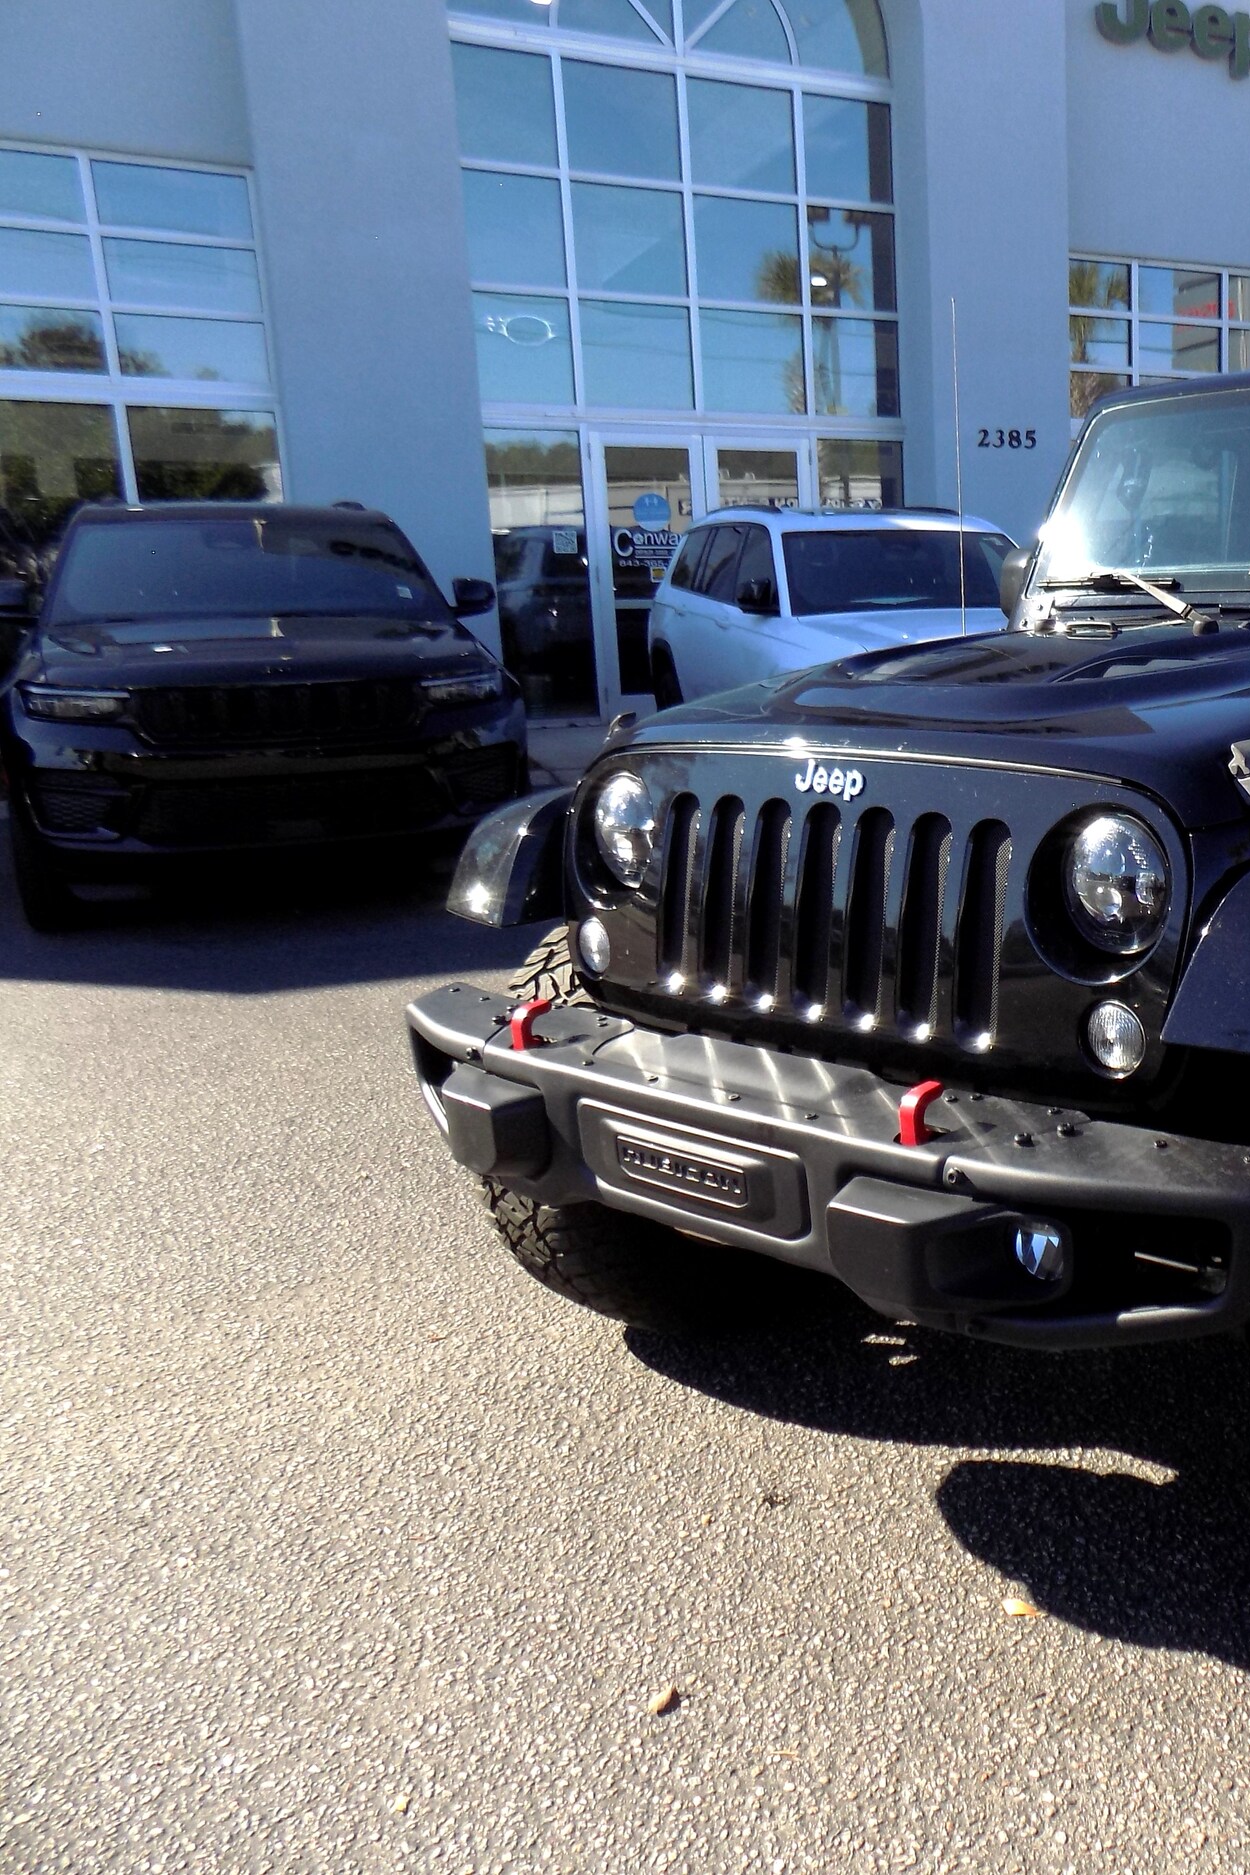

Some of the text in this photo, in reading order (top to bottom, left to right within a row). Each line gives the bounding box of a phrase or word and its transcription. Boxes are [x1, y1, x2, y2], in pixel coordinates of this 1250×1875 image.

[977, 429, 1037, 449] 2385
[614, 528, 683, 557] Conwa
[794, 758, 866, 802] Jeep
[621, 1146, 742, 1194] RUBICON
